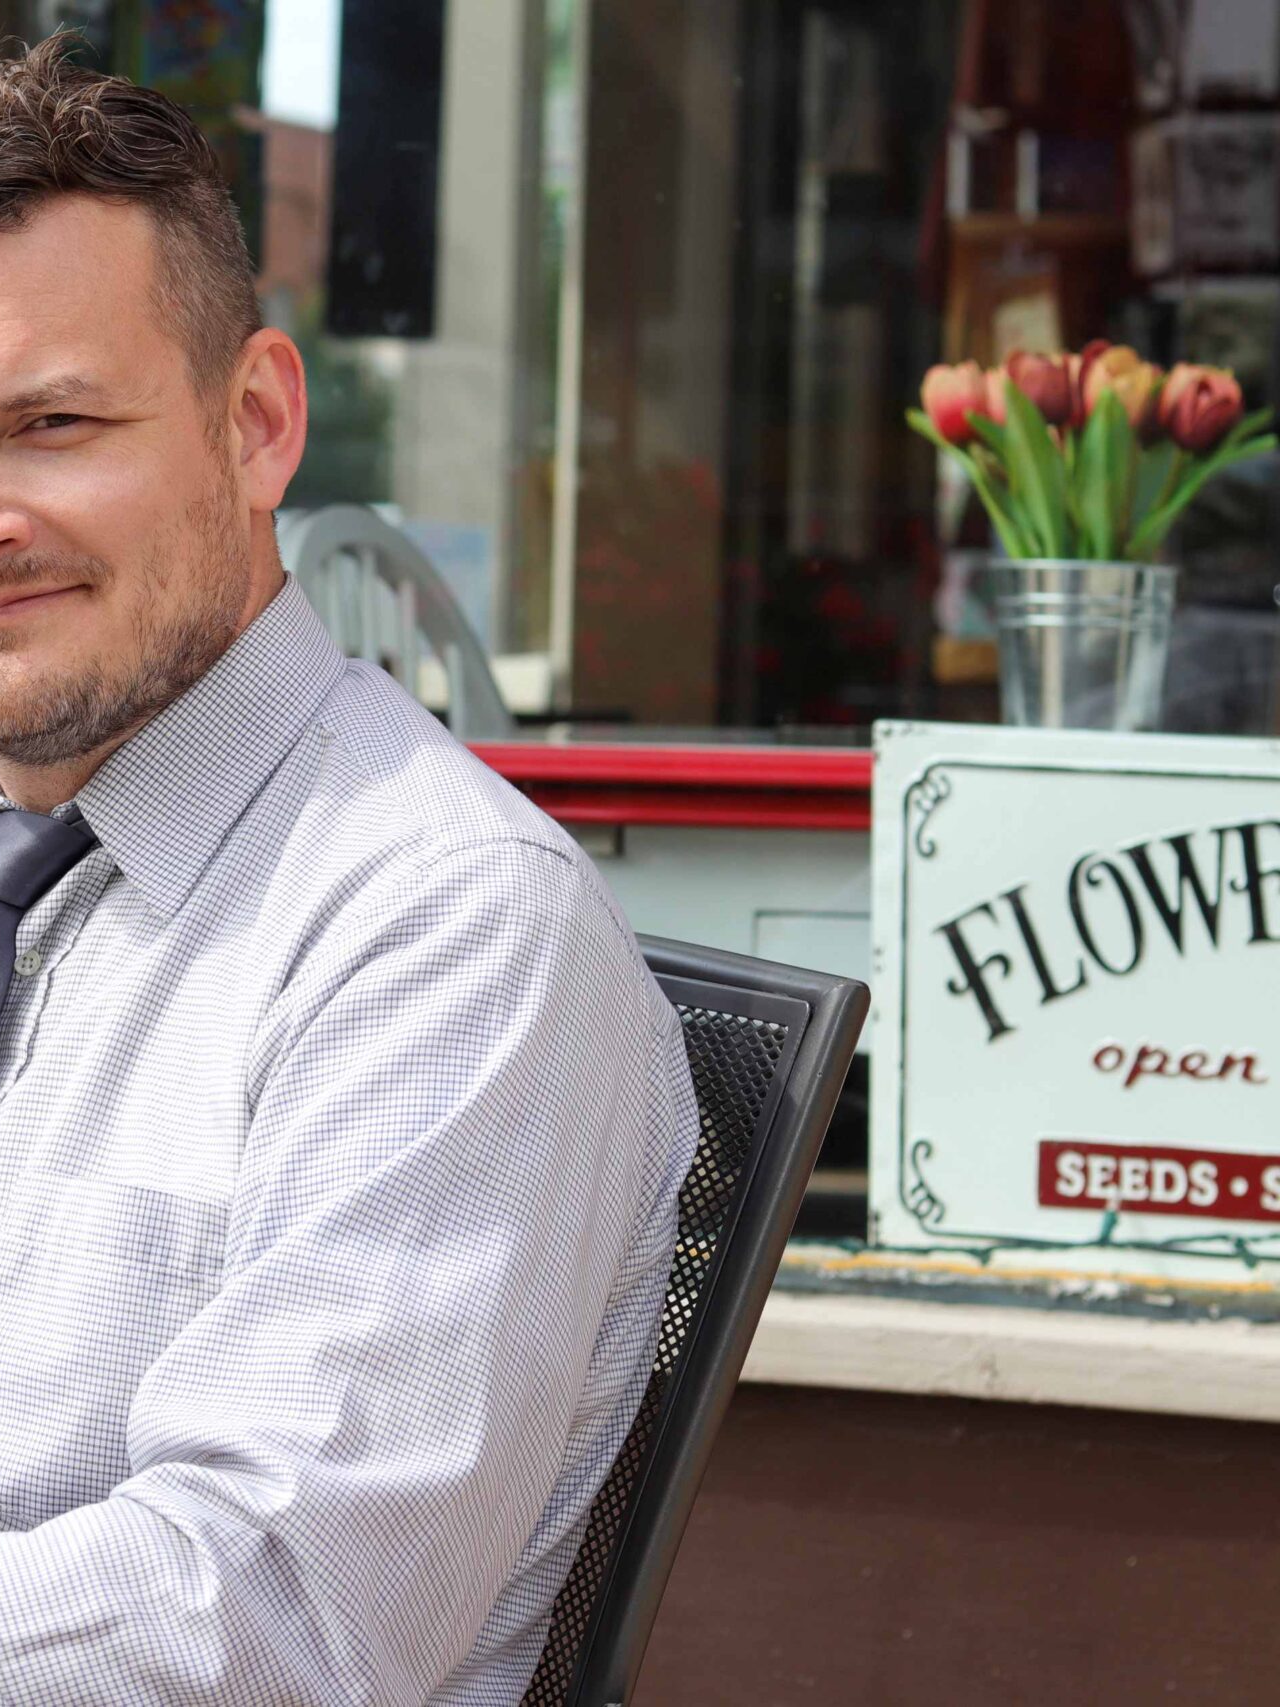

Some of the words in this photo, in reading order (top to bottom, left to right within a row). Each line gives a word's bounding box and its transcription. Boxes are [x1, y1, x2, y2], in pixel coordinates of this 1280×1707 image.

[933, 820, 1280, 1042] FLOWE
[1093, 1044, 1269, 1090] open
[1055, 1150, 1219, 1207] SEEDS
